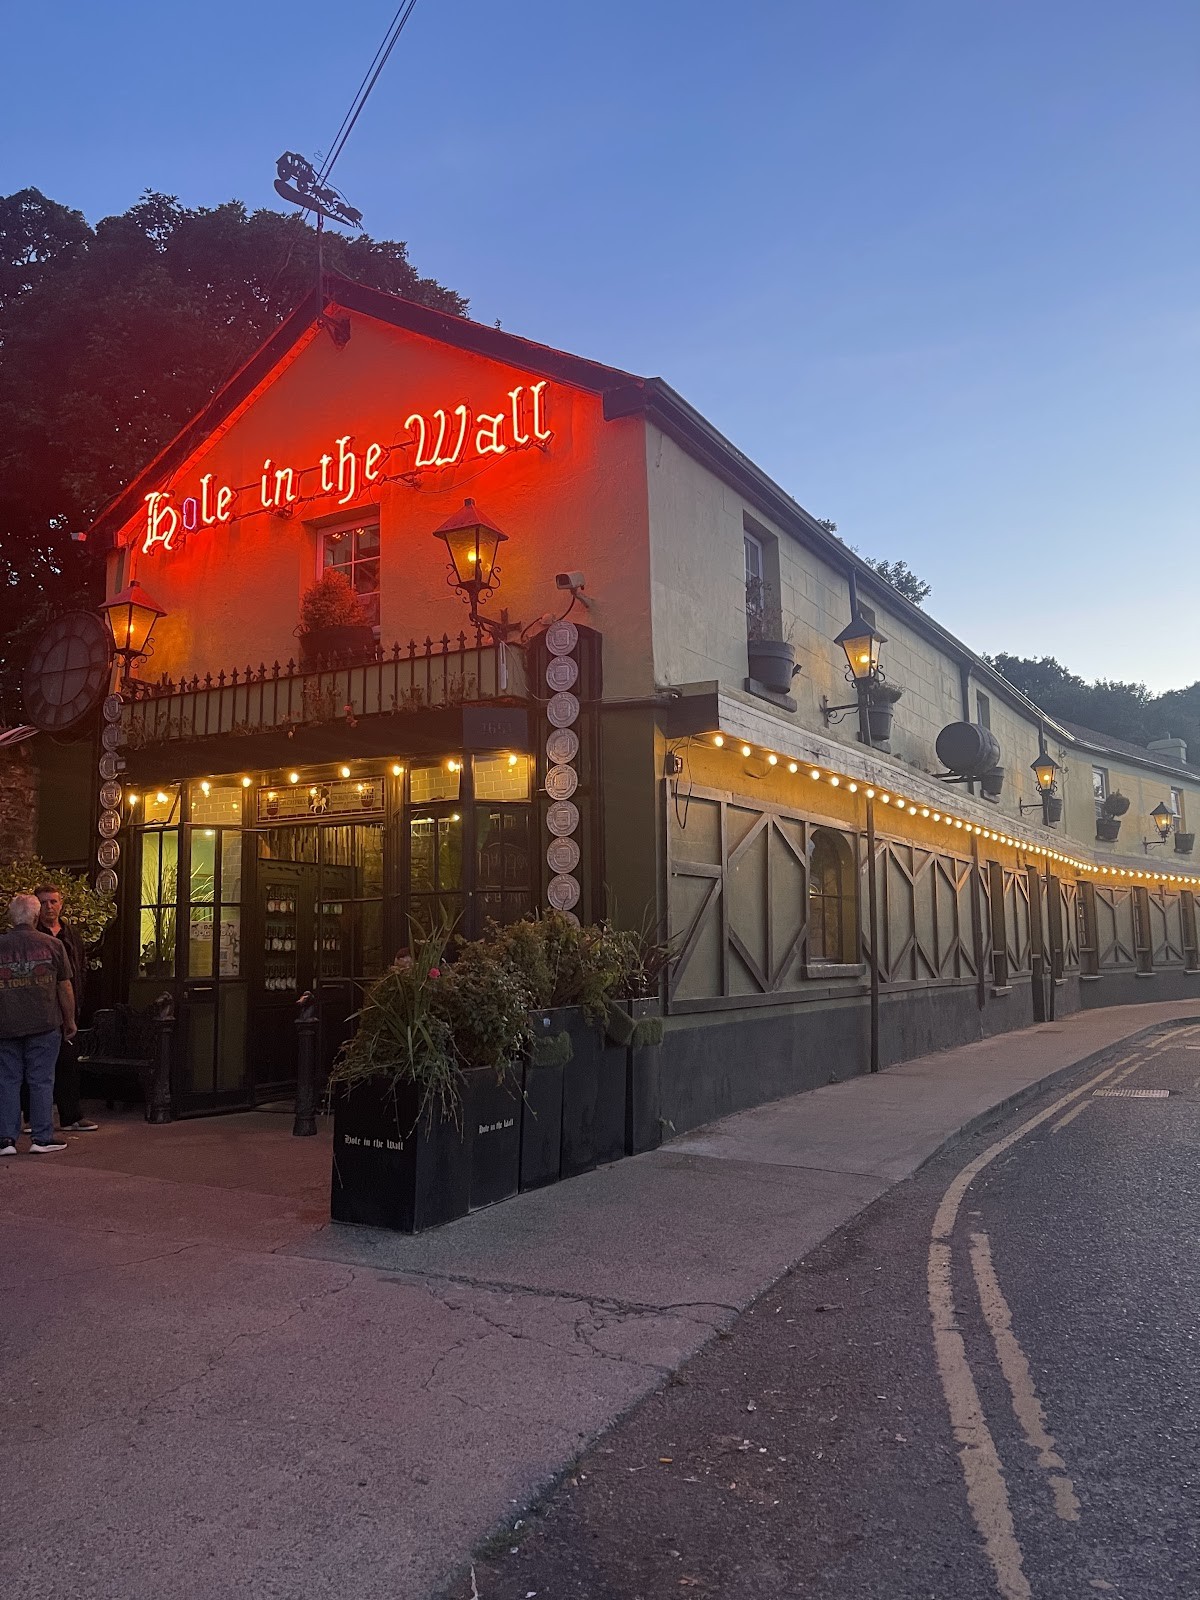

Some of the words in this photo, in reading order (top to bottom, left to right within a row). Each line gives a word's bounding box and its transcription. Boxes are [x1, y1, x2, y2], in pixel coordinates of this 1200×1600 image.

[142, 473, 231, 554] Hole
[261, 459, 296, 508] in
[321, 435, 382, 505] the
[405, 380, 552, 467] Wall
[344, 1134, 361, 1146] Hole
[363, 1136, 371, 1147] in
[373, 1138, 383, 1149] the
[386, 1139, 404, 1151] Wall
